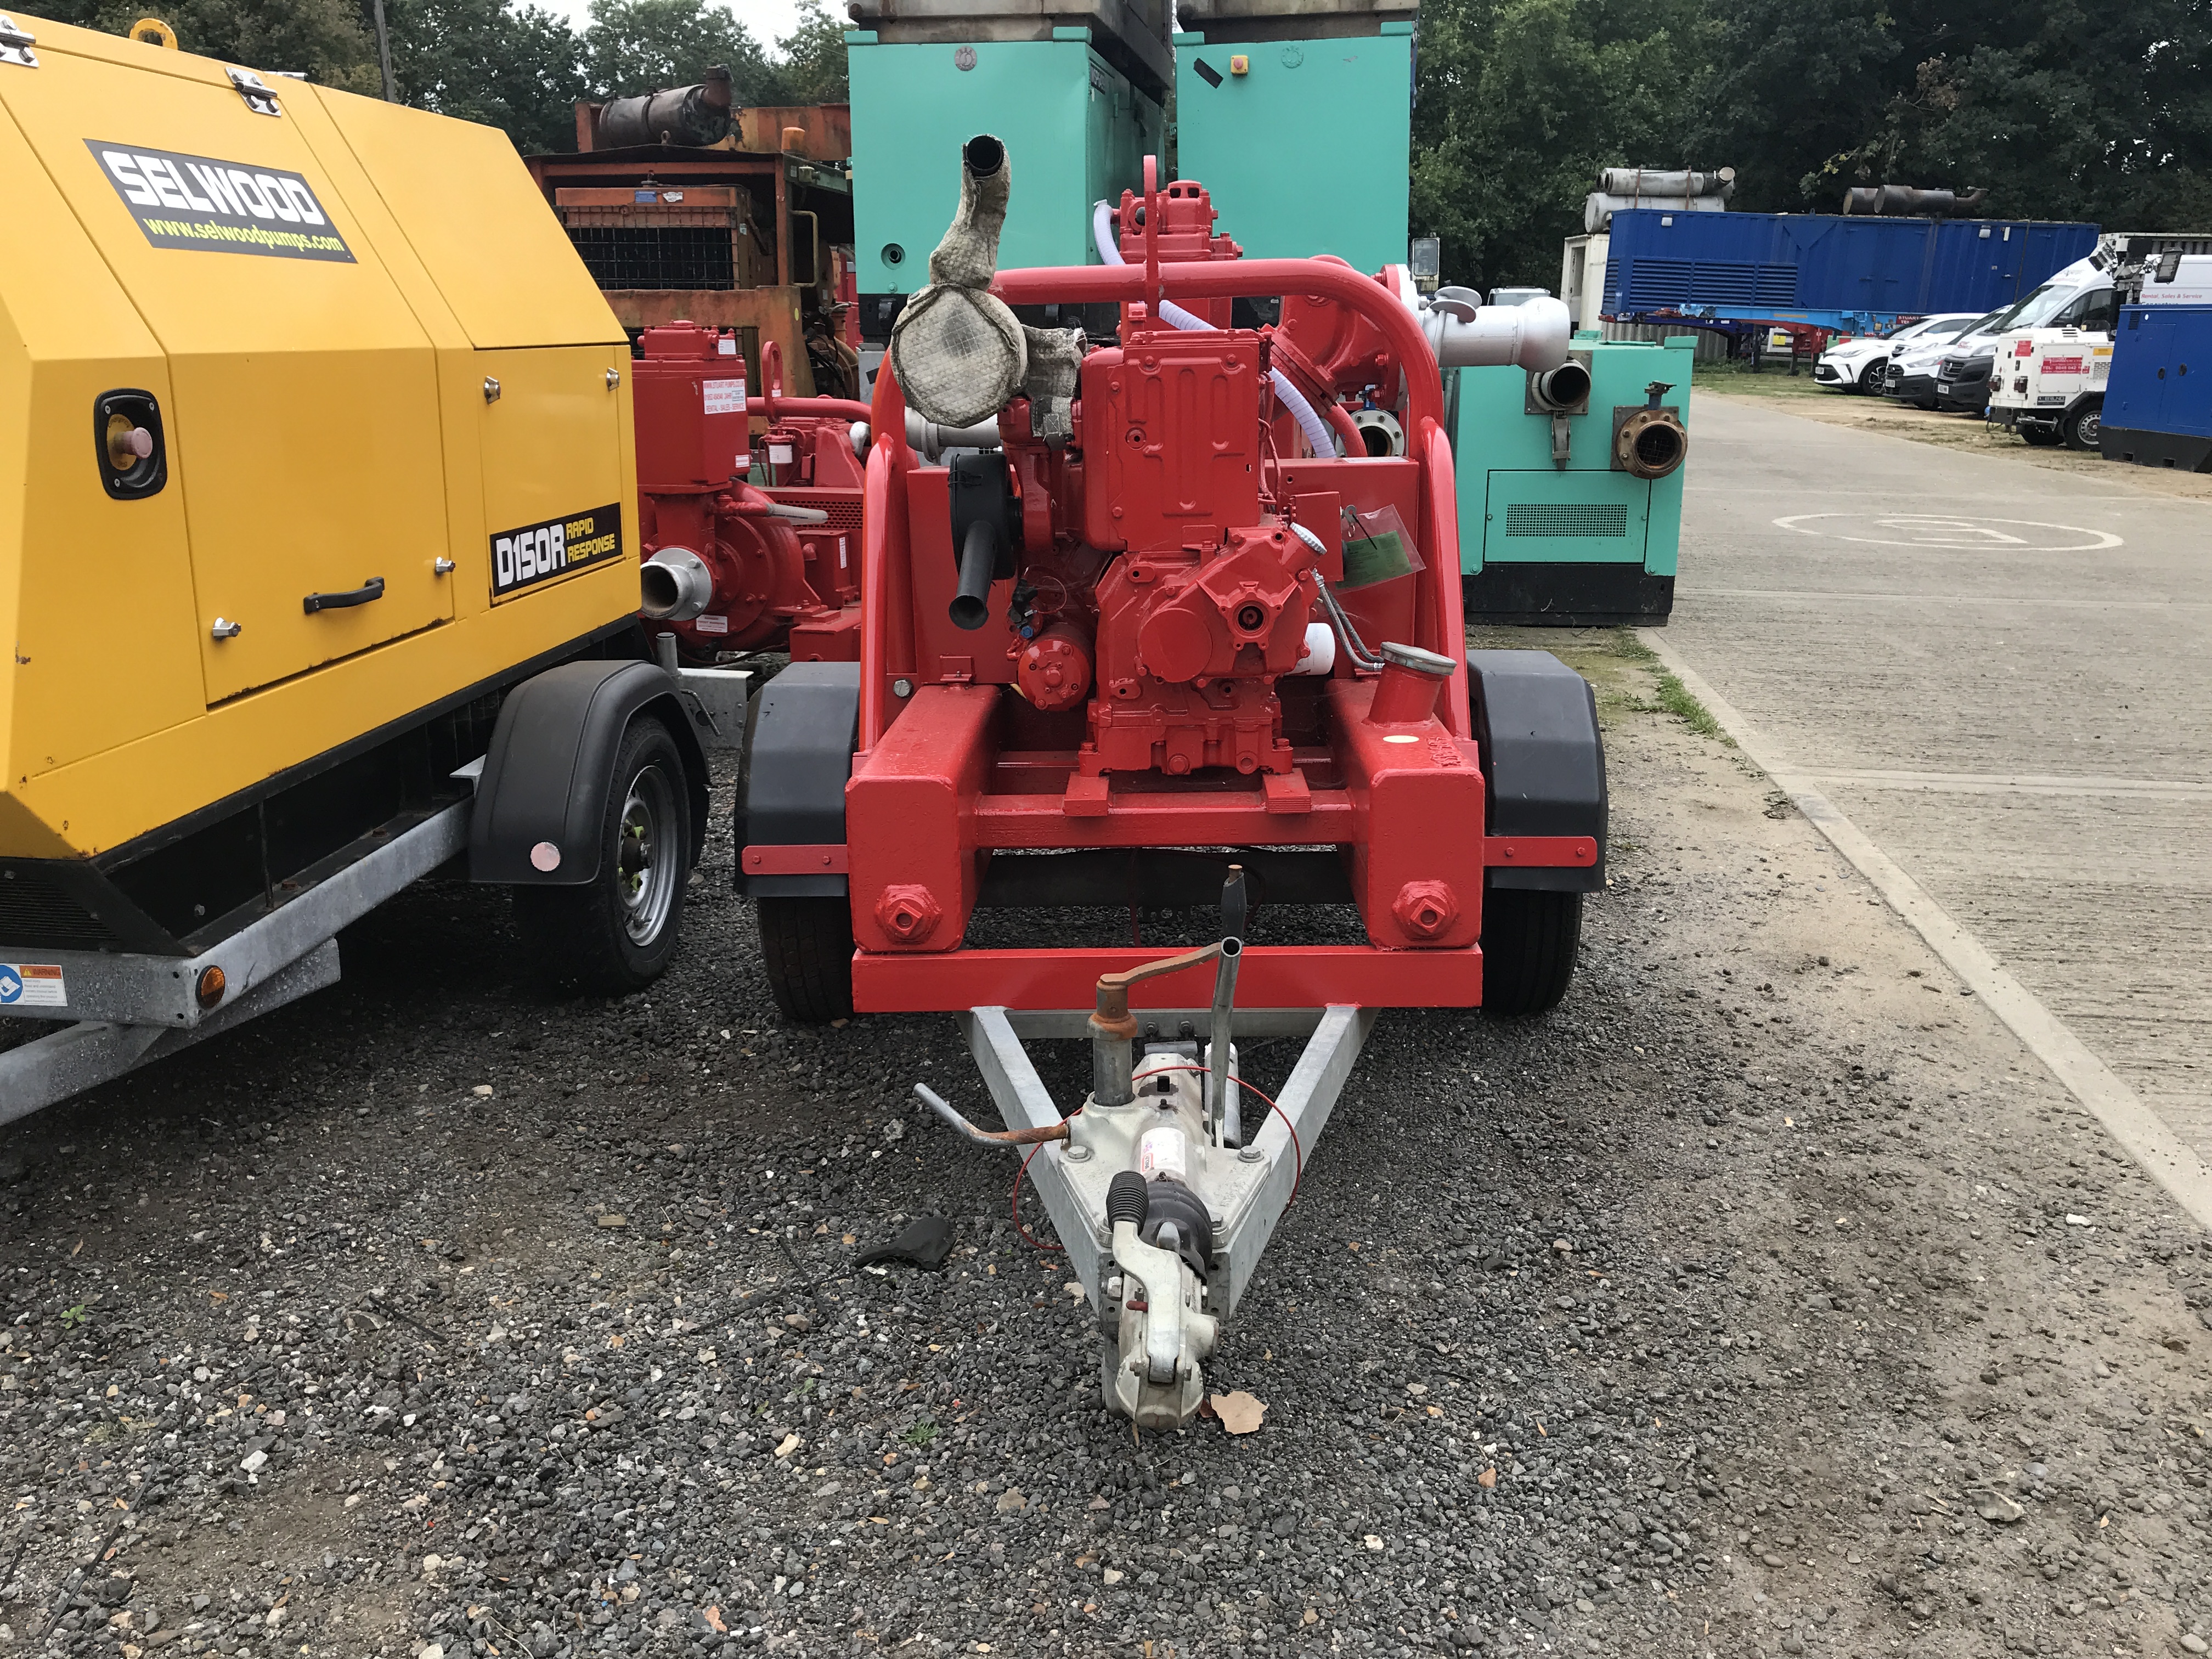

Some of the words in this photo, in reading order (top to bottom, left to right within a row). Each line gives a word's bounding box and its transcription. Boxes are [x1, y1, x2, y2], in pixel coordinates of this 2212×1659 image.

[103, 150, 325, 225] SELWOOD
[143, 218, 345, 252] www.selwoodpumps.com
[566, 517, 594, 540] RAPID
[496, 524, 566, 587] D150R
[567, 533, 615, 563] RESPONSE
